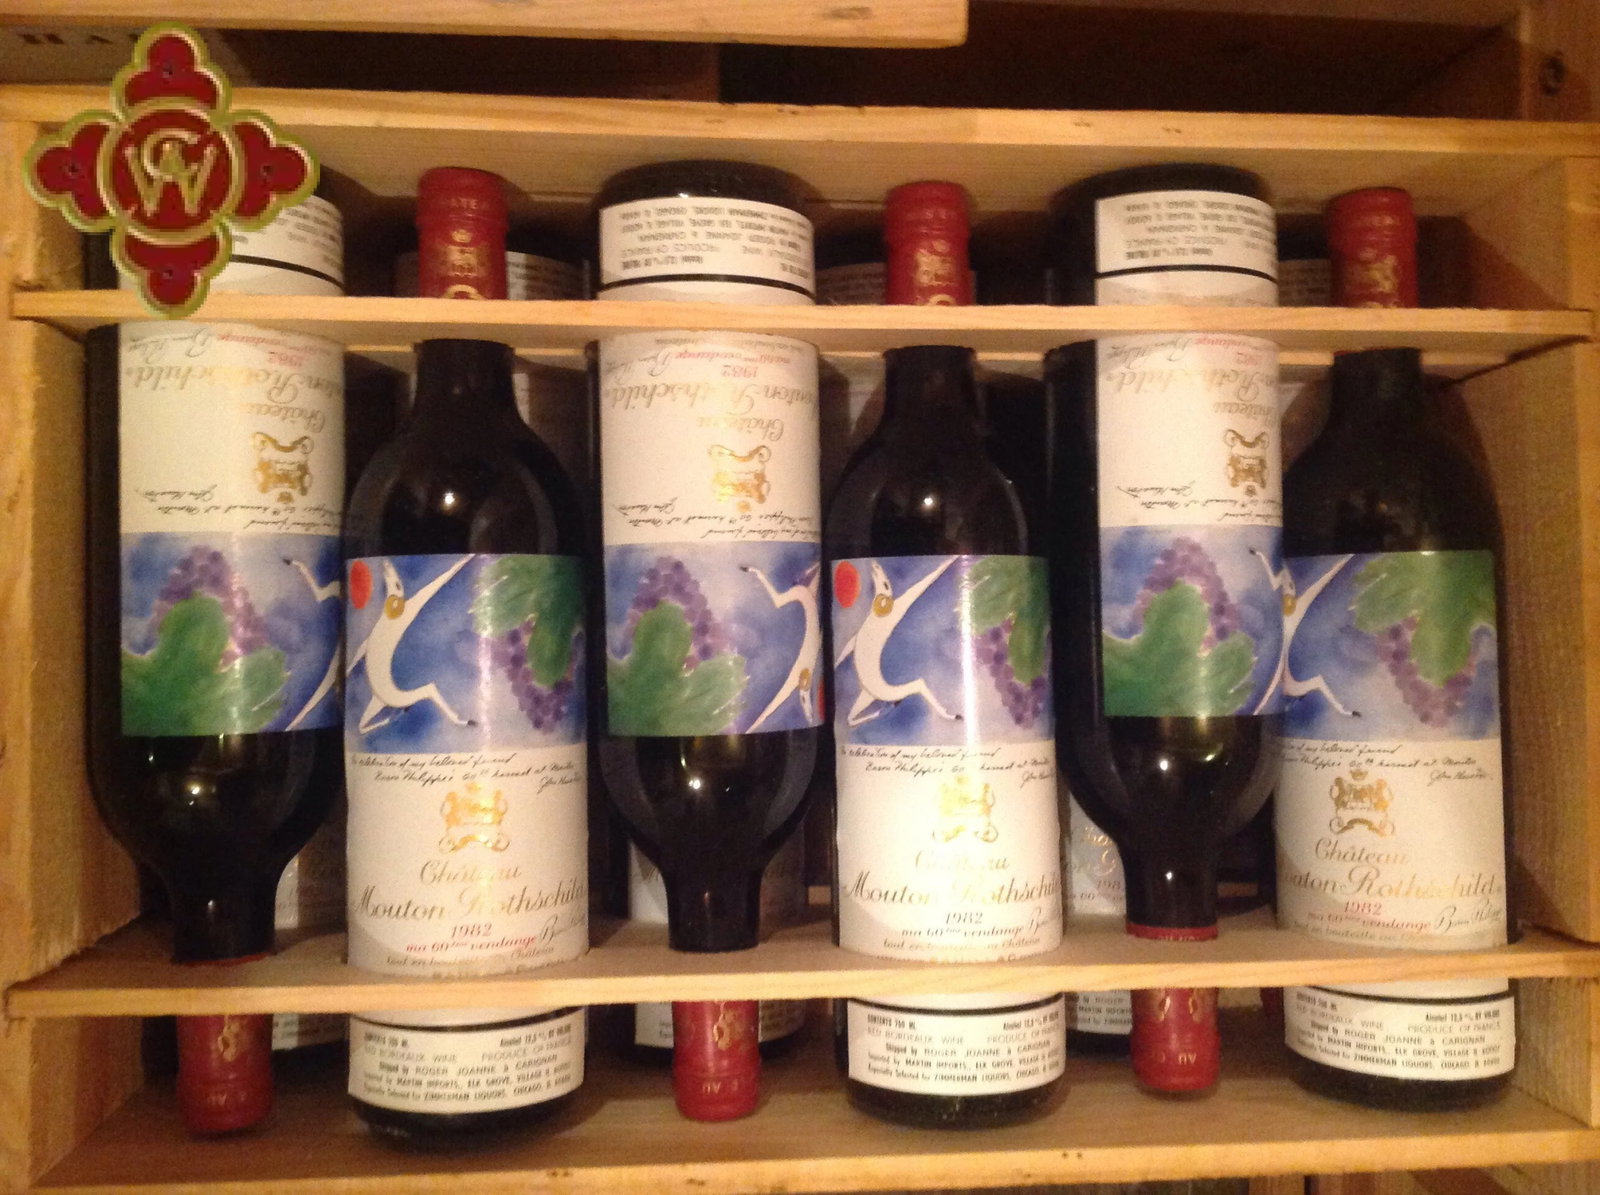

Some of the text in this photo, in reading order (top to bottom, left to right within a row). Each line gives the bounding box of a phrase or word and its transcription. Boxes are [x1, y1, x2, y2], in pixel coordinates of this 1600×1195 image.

[1315, 838, 1408, 864] Château
[1290, 872, 1342, 893] uton
[355, 885, 445, 920] Mouton
[1344, 901, 1381, 916] 1982
[945, 912, 983, 924] 1982
[452, 923, 492, 937] 1982
[925, 1048, 956, 1056] ROGER
